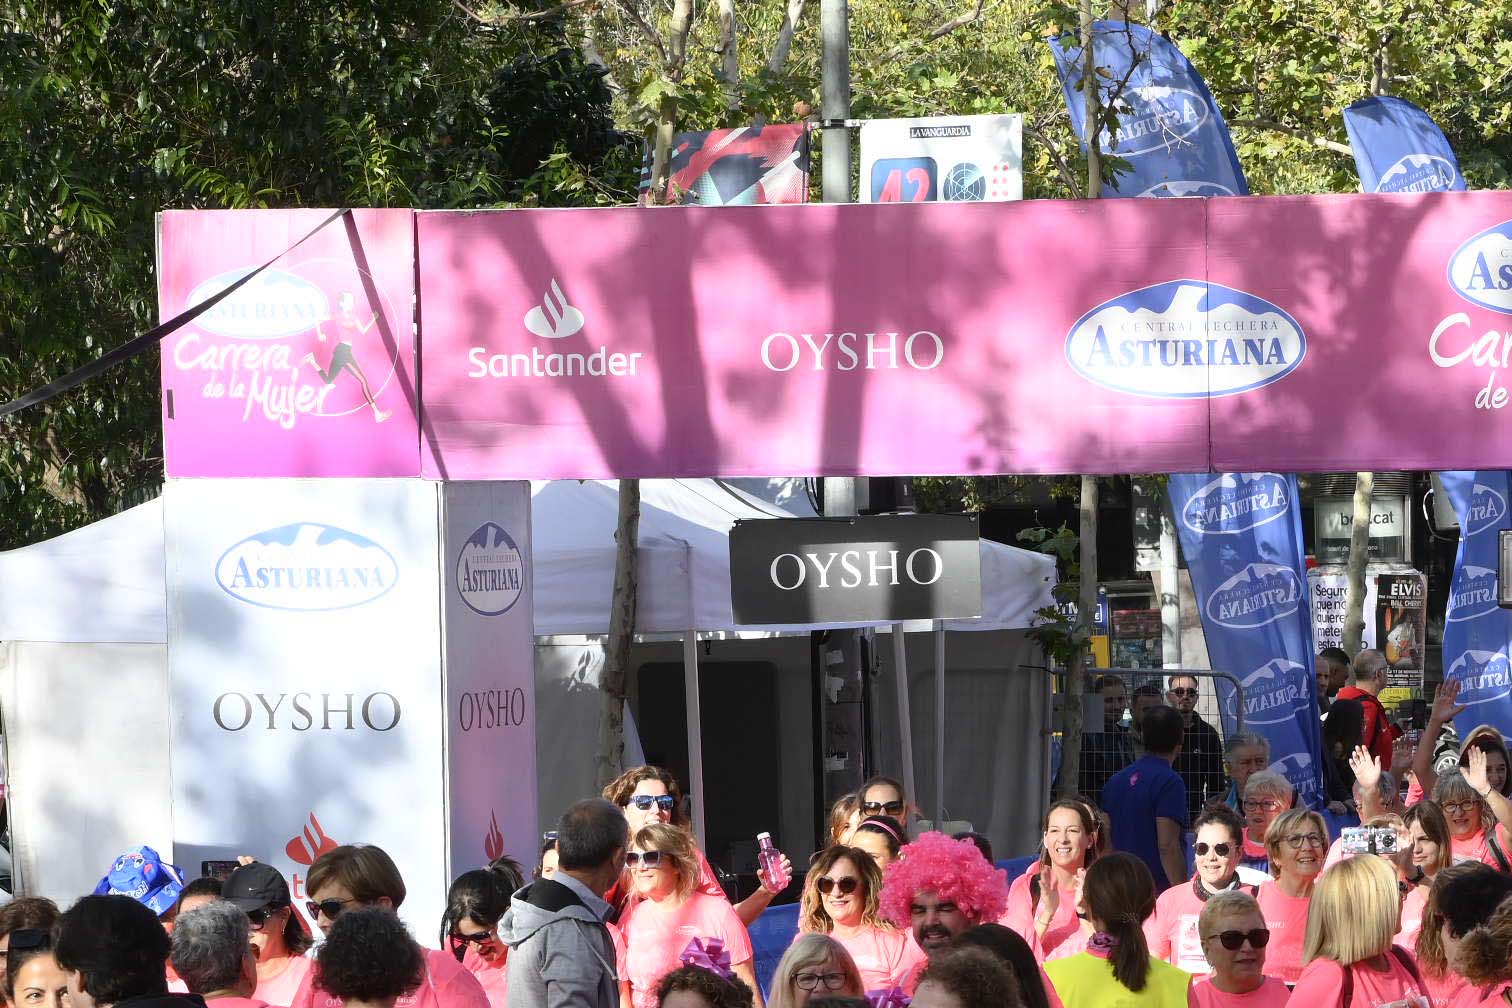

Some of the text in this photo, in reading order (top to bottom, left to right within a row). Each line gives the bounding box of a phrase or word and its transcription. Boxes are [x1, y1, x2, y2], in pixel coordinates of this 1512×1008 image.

[910, 126, 970, 137] LA VANGUARDIA
[173, 333, 292, 373] Carrera
[468, 346, 643, 378] Santander
[760, 329, 945, 373] OYSHO
[1086, 323, 1289, 368] ASTURIANA
[202, 364, 336, 429] de la Mujer
[1475, 372, 1509, 411] de
[229, 555, 385, 590] ASTURIANA
[461, 556, 520, 593] ASTURIANA
[769, 547, 944, 591] OYSHO
[1316, 602, 1332, 614] que
[1390, 583, 1422, 597] ELVIS
[212, 691, 402, 732] OYSHO
[459, 686, 526, 732] OYSHO
